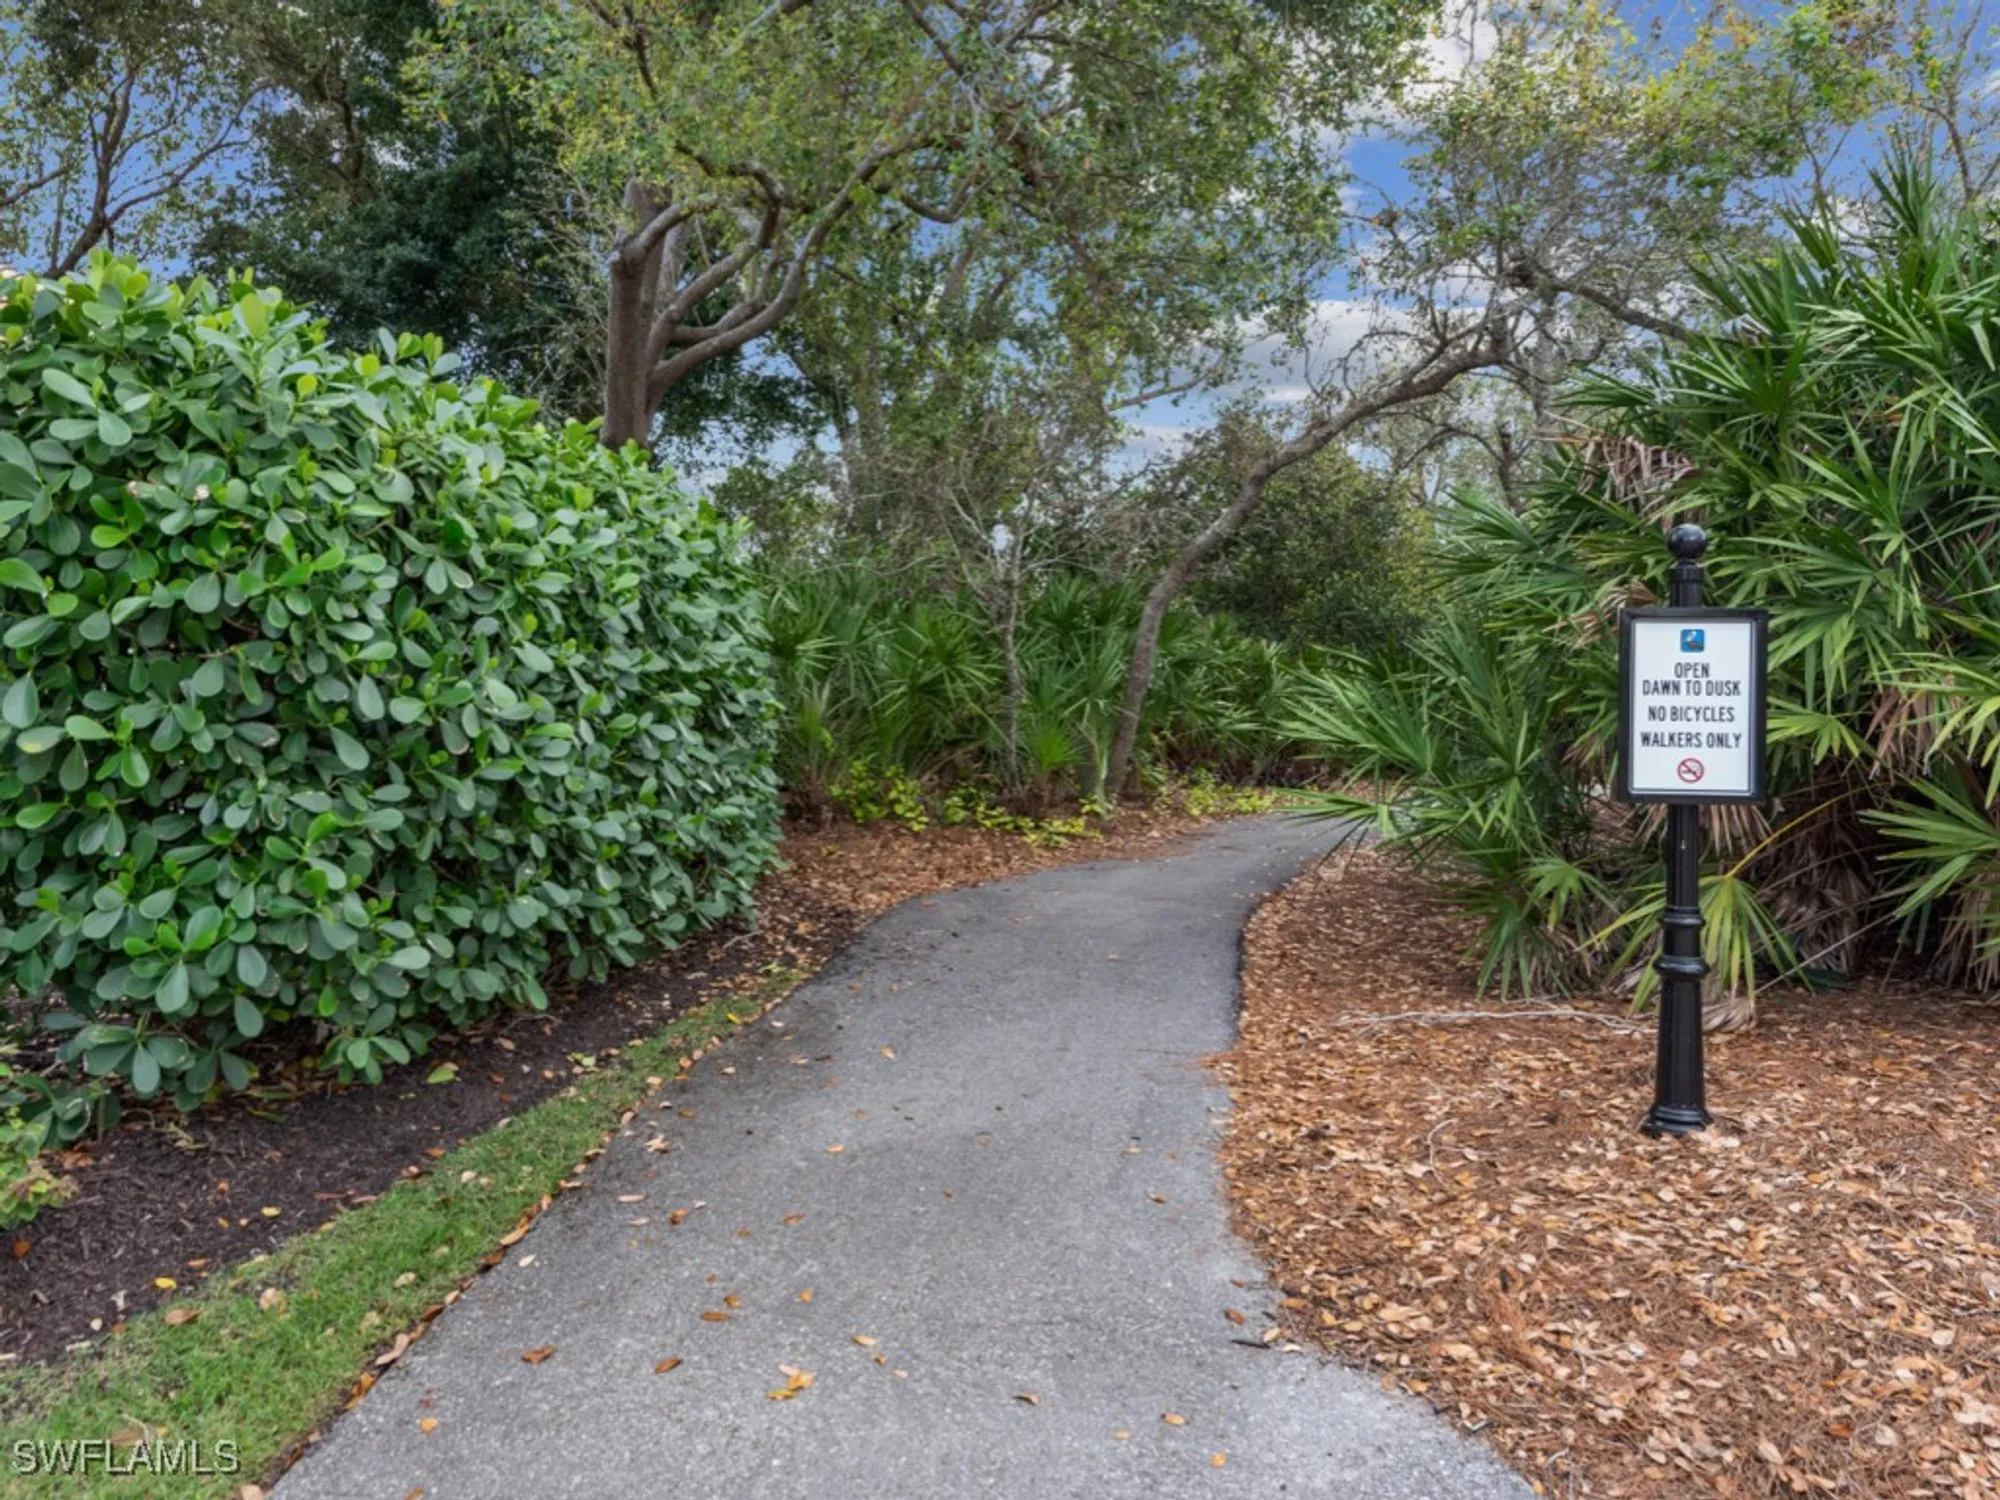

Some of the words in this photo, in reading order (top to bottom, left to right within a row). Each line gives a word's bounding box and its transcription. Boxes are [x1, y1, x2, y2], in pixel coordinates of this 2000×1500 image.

[1674, 662, 1710, 678] OPEN
[1642, 680, 1681, 696] DAWN
[1685, 680, 1701, 696] TO
[1705, 680, 1741, 696] DUSK
[1648, 706, 1667, 722] NO
[1670, 706, 1735, 722] BICYCLES
[1641, 732, 1701, 748] WALKERS
[1706, 732, 1742, 749] ONLY
